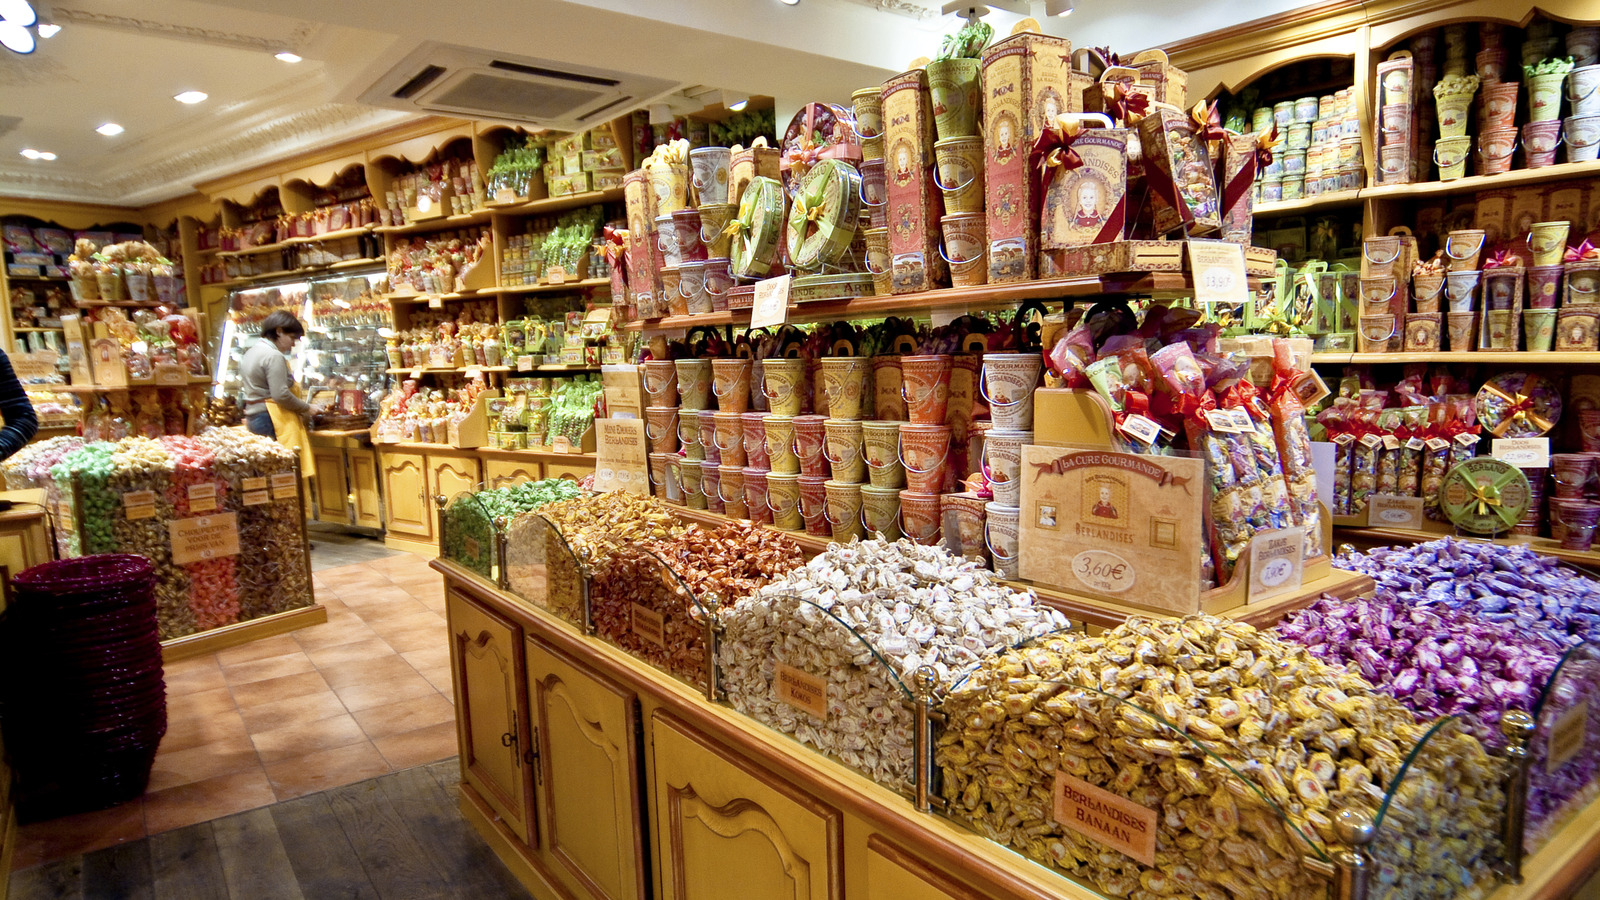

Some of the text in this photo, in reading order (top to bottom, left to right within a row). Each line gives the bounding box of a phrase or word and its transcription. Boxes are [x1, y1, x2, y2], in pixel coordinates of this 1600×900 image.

[1084, 137, 1122, 148] GOURMANDE
[1082, 158, 1120, 180] ANDISES
[843, 283, 873, 294] ARTI
[1075, 455, 1100, 466] CURE
[1101, 455, 1162, 478] GOURMANDE
[1075, 522, 1134, 544] BERLANDISES
[1078, 556, 1127, 580] 3,60€
[780, 671, 822, 697] BERLANDISES
[790, 687, 812, 705] KOKOS
[1064, 785, 1147, 833] BERLANDISES
[1075, 807, 1131, 843] BANAAN
